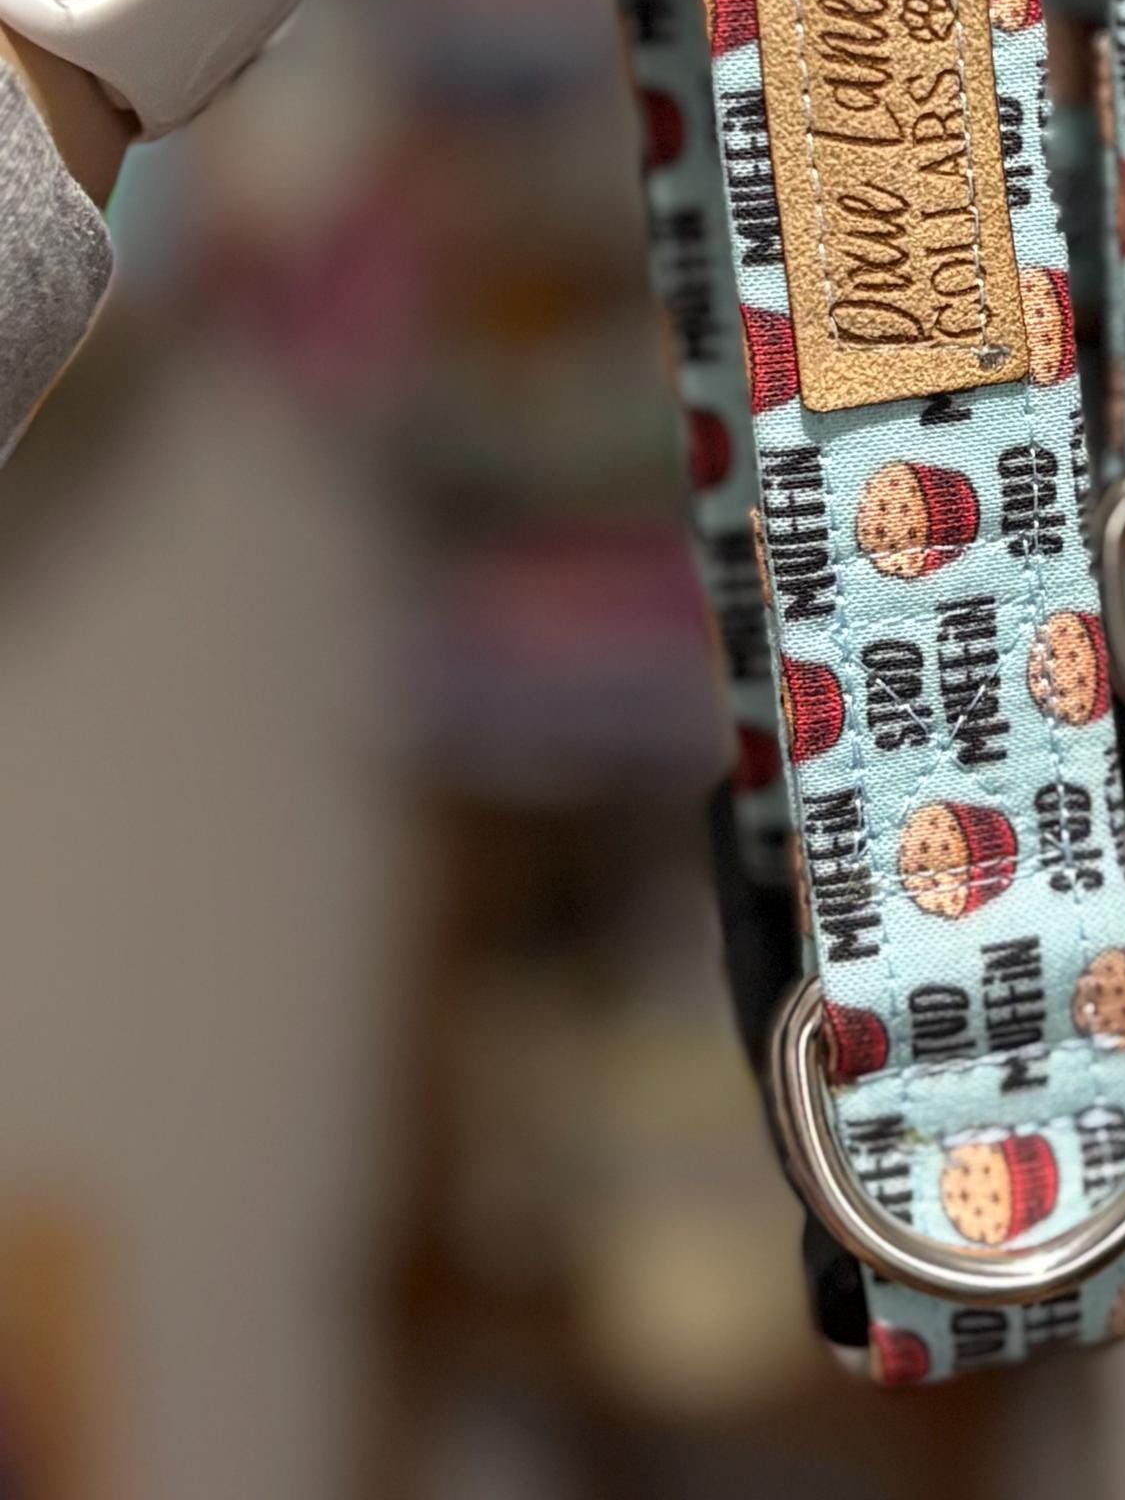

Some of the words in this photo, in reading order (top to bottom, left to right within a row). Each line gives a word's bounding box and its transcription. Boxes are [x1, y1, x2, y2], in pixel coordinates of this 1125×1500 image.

[903, 68, 994, 338] COLLARS
[827, 181, 933, 344] Dixie
[998, 444, 1067, 557] STUD
[862, 639, 933, 750] STUD
[1034, 782, 1105, 893] STUD
[908, 984, 977, 1061] TUD
